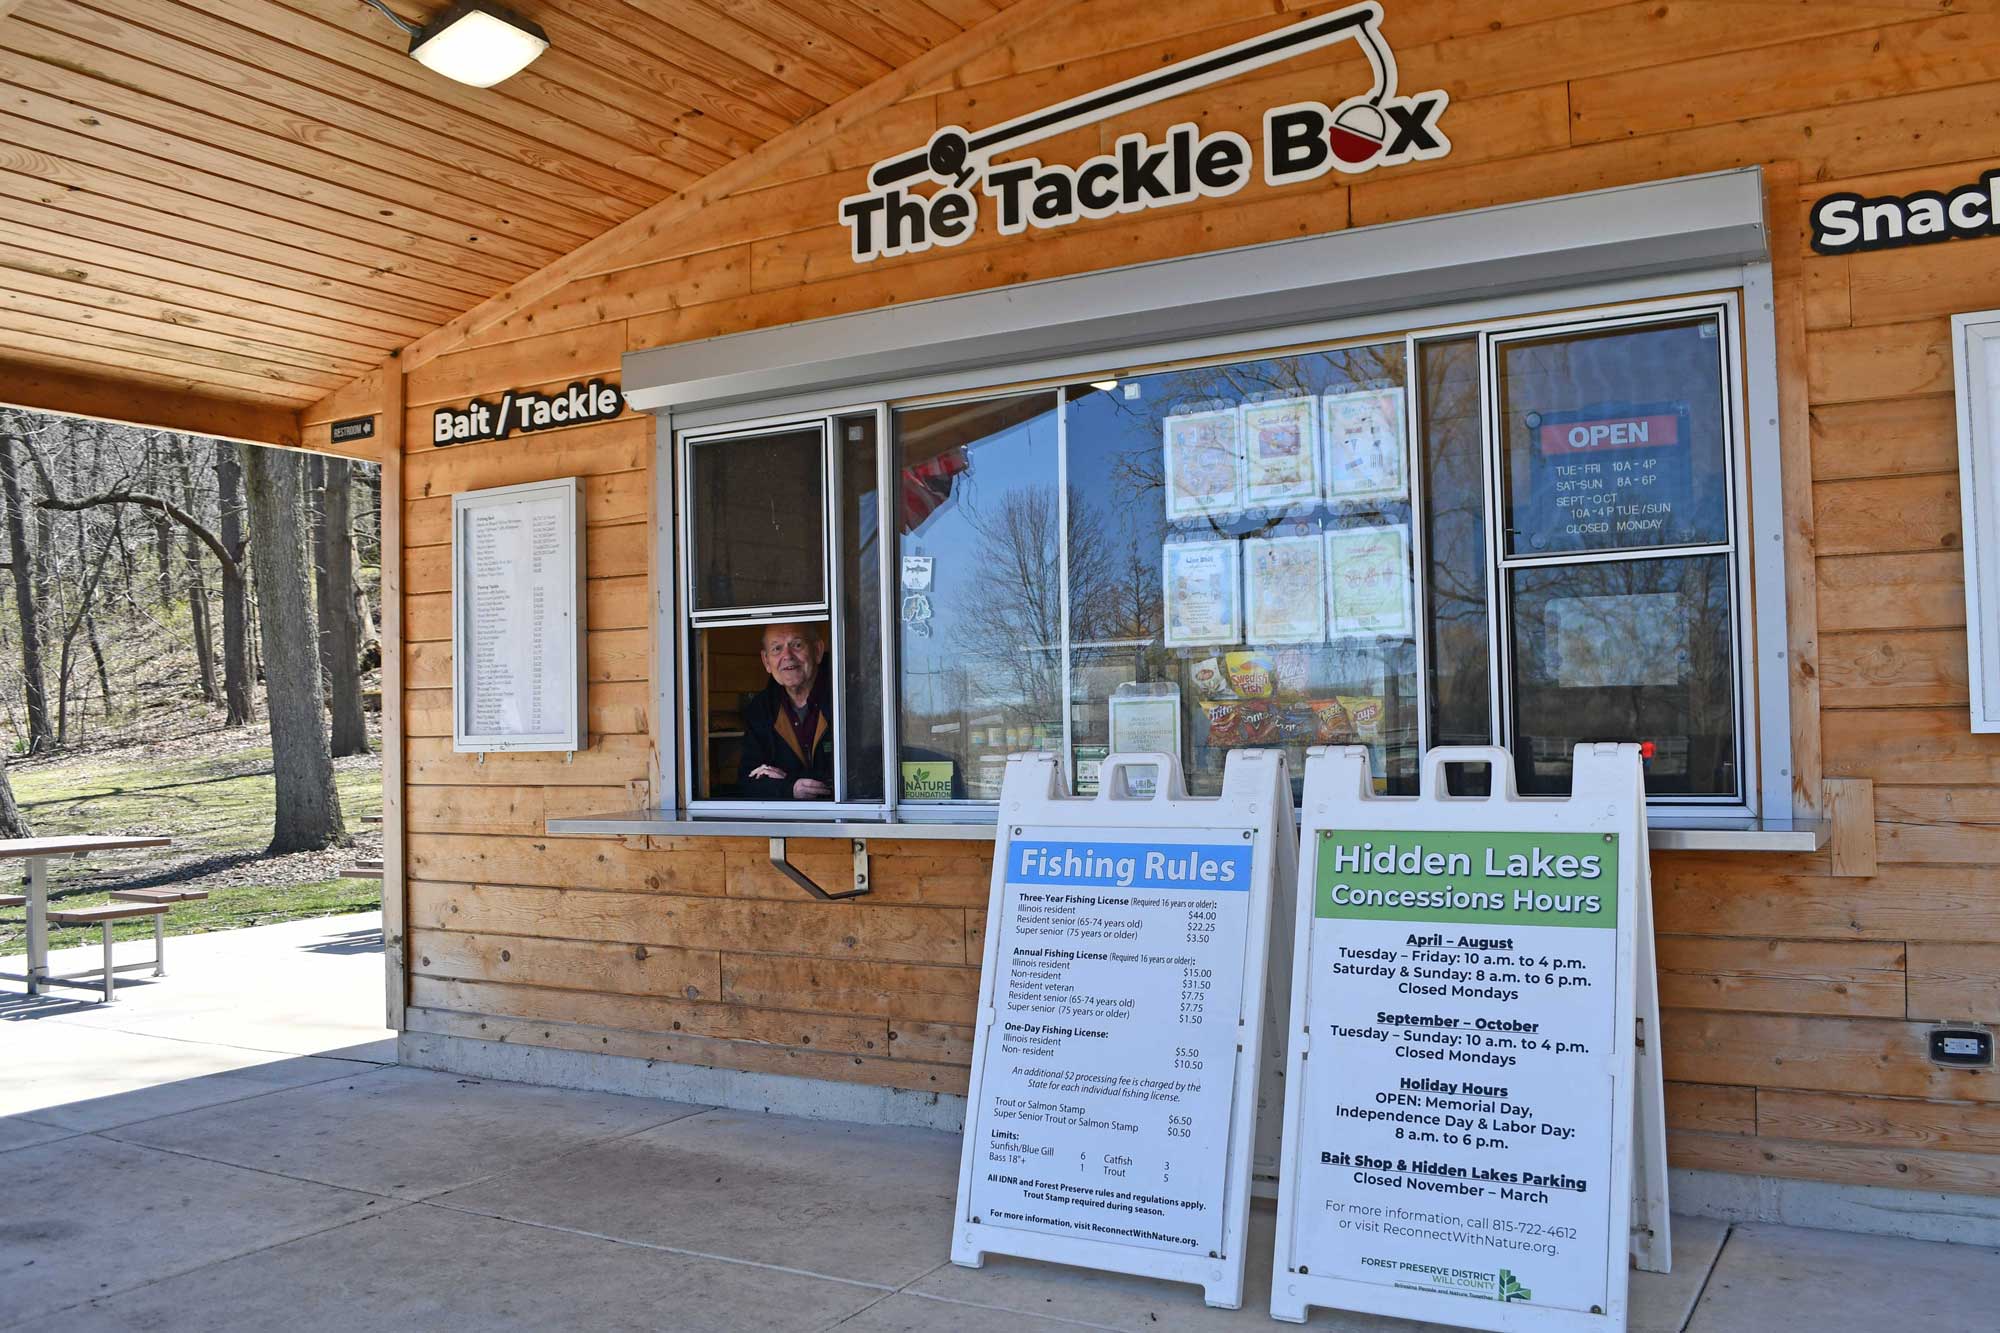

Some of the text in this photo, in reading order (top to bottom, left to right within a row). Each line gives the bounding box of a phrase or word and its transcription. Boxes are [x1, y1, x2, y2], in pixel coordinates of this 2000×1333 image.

[844, 196, 971, 256] The
[988, 131, 1245, 227] Tackle
[1818, 176, 2000, 246] Snac
[1568, 421, 1649, 448] OPEN
[1566, 519, 1663, 535] CLOSED MONDAY
[1231, 672, 1269, 686] Swedish
[1242, 683, 1263, 694] Fish
[905, 781, 951, 791] NATURE
[1020, 847, 1235, 887] Fishing Rules
[1334, 841, 1600, 878] Hidden Lakes
[1019, 893, 1064, 903] Three-Year
[1064, 894, 1096, 906] Fishing
[1097, 895, 1129, 906] License
[1162, 898, 1169, 907] 16
[1170, 900, 1186, 909] years
[1331, 884, 1601, 913] Concessions Hours
[1017, 903, 1076, 914] Illinois resident
[1188, 910, 1217, 920] $44.00
[1016, 914, 1143, 930] Resident senior (65-74 years old)
[1187, 921, 1215, 932] $22.25
[1405, 933, 1442, 946] April
[1457, 935, 1513, 949] August
[1338, 946, 1397, 963] Tuesday
[1412, 949, 1460, 966] Friday:
[1464, 952, 1479, 964] 10
[1483, 955, 1515, 966] a.m.
[1518, 955, 1534, 967] to
[1538, 955, 1549, 967] 4
[1553, 958, 1586, 971] p.m.
[1010, 968, 1062, 980] Non-resident
[1183, 967, 1212, 978] $15.00
[1332, 962, 1591, 988] Saturday & Sunday: 8 a.m. to 6 p.m.
[1182, 978, 1211, 990] $31.50
[1398, 982, 1518, 1002] Closed Mondays
[1004, 1022, 1109, 1038] One-Day Fishing License:
[1376, 1011, 1460, 1028] September
[1474, 1017, 1539, 1033] October
[1175, 1047, 1199, 1058] $5.50
[1174, 1058, 1203, 1070] $10.50
[1400, 1077, 1508, 1097] Holiday Hours
[995, 1096, 1086, 1116] Trout or Salmon Stamp
[1375, 1091, 1533, 1119] OPEN: Memorial Day,
[1168, 1114, 1192, 1126] $6.50
[1336, 1104, 1575, 1140] Independence Day & Labor Day:
[991, 1128, 1019, 1140] Limits:
[988, 1151, 1006, 1162] Bass
[990, 1140, 1054, 1157] Sunfish/Blue Gill
[1080, 1151, 1086, 1160] 6
[1080, 1163, 1084, 1172] 1
[1103, 1153, 1133, 1166] Catfish
[1163, 1161, 1170, 1170] 3
[1103, 1165, 1126, 1177] Trout
[1163, 1173, 1169, 1183] 5
[1320, 1151, 1587, 1191] Bait Shop & Hidden Lakes Parking
[987, 1173, 1206, 1211] All IDNR and Forest Preserve rules and regulations apply.
[1353, 1171, 1402, 1188] Closed
[1406, 1177, 1485, 1197] November
[1500, 1187, 1548, 1204] March
[990, 1208, 1199, 1247] For more information, visit ReconnectWithNature.org.
[1325, 1199, 1577, 1240] For more information, call 815-722-4612
[1338, 1219, 1559, 1257] or visit ReconnectWithNature.org.
[1361, 1256, 1496, 1282] FOREST PRESERVE DISTRICT
[1431, 1274, 1495, 1290] WILL COUNTY
